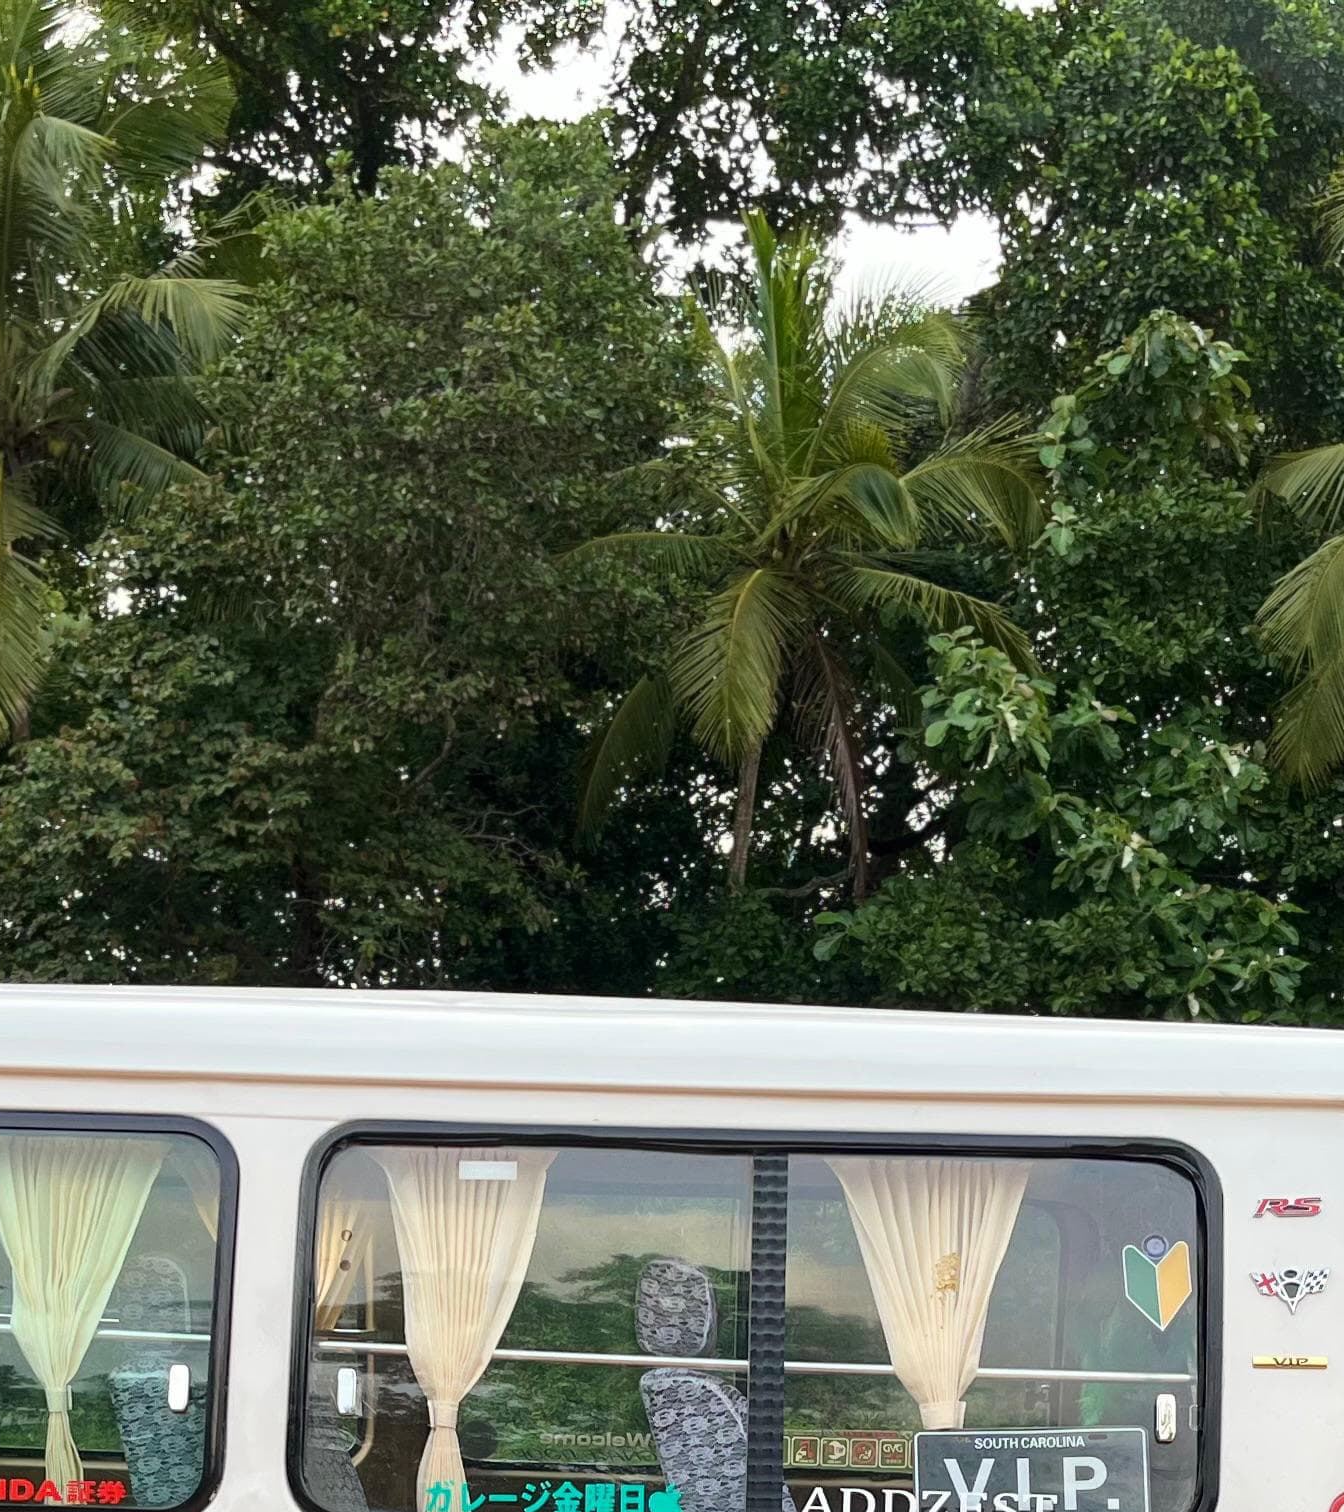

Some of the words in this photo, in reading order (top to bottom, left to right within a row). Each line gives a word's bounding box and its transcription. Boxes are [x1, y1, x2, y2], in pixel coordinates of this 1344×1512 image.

[1253, 1197, 1323, 1218] RS
[1272, 1357, 1310, 1366] VIP
[974, 1436, 1019, 1450] SOUTH
[1020, 1436, 1086, 1449] CAROLINA
